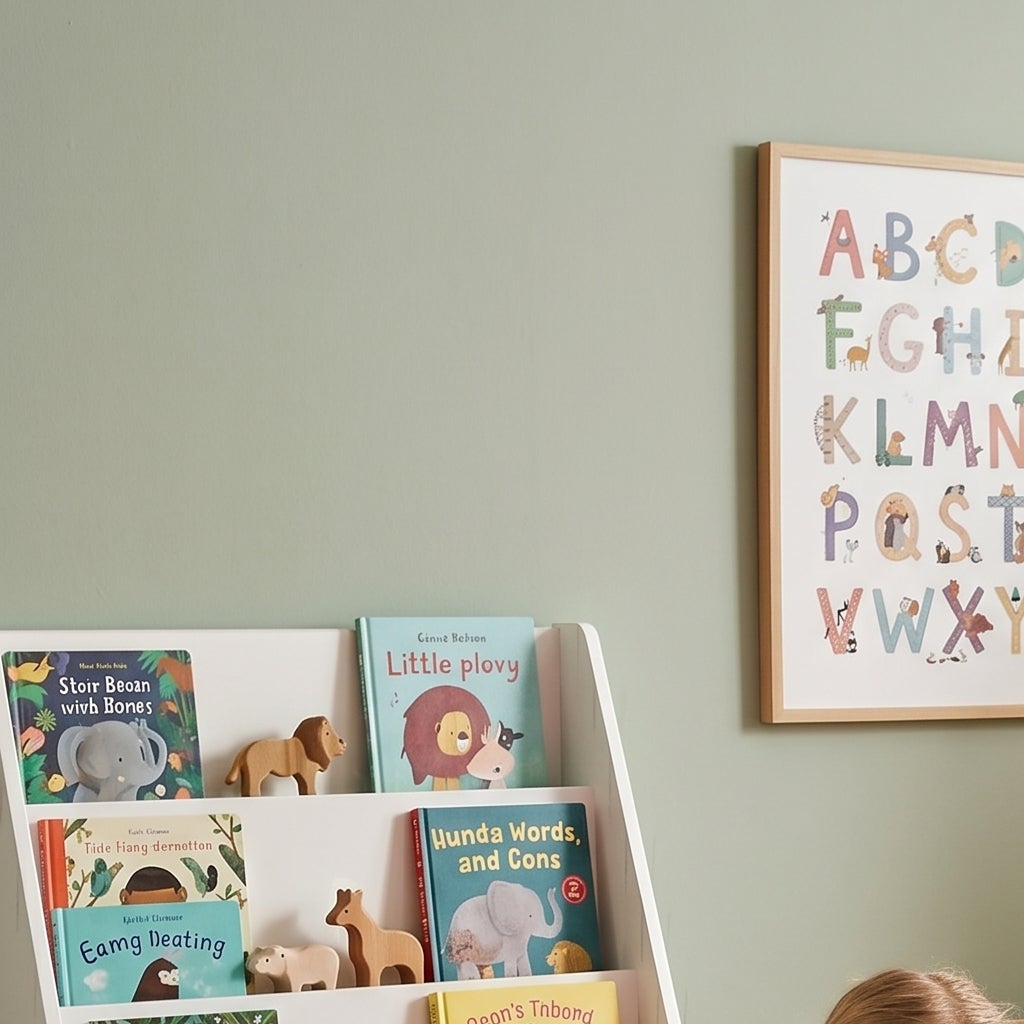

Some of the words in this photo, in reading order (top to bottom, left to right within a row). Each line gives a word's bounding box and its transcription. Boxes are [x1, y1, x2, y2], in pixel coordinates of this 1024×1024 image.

[387, 651, 451, 676] Little
[461, 652, 519, 683] plovy
[59, 676, 100, 695] Stoir
[105, 676, 151, 693] Beoan
[103, 697, 153, 715] Bones
[508, 820, 582, 846] Words,
[458, 849, 500, 874] and
[508, 847, 561, 870] Cons
